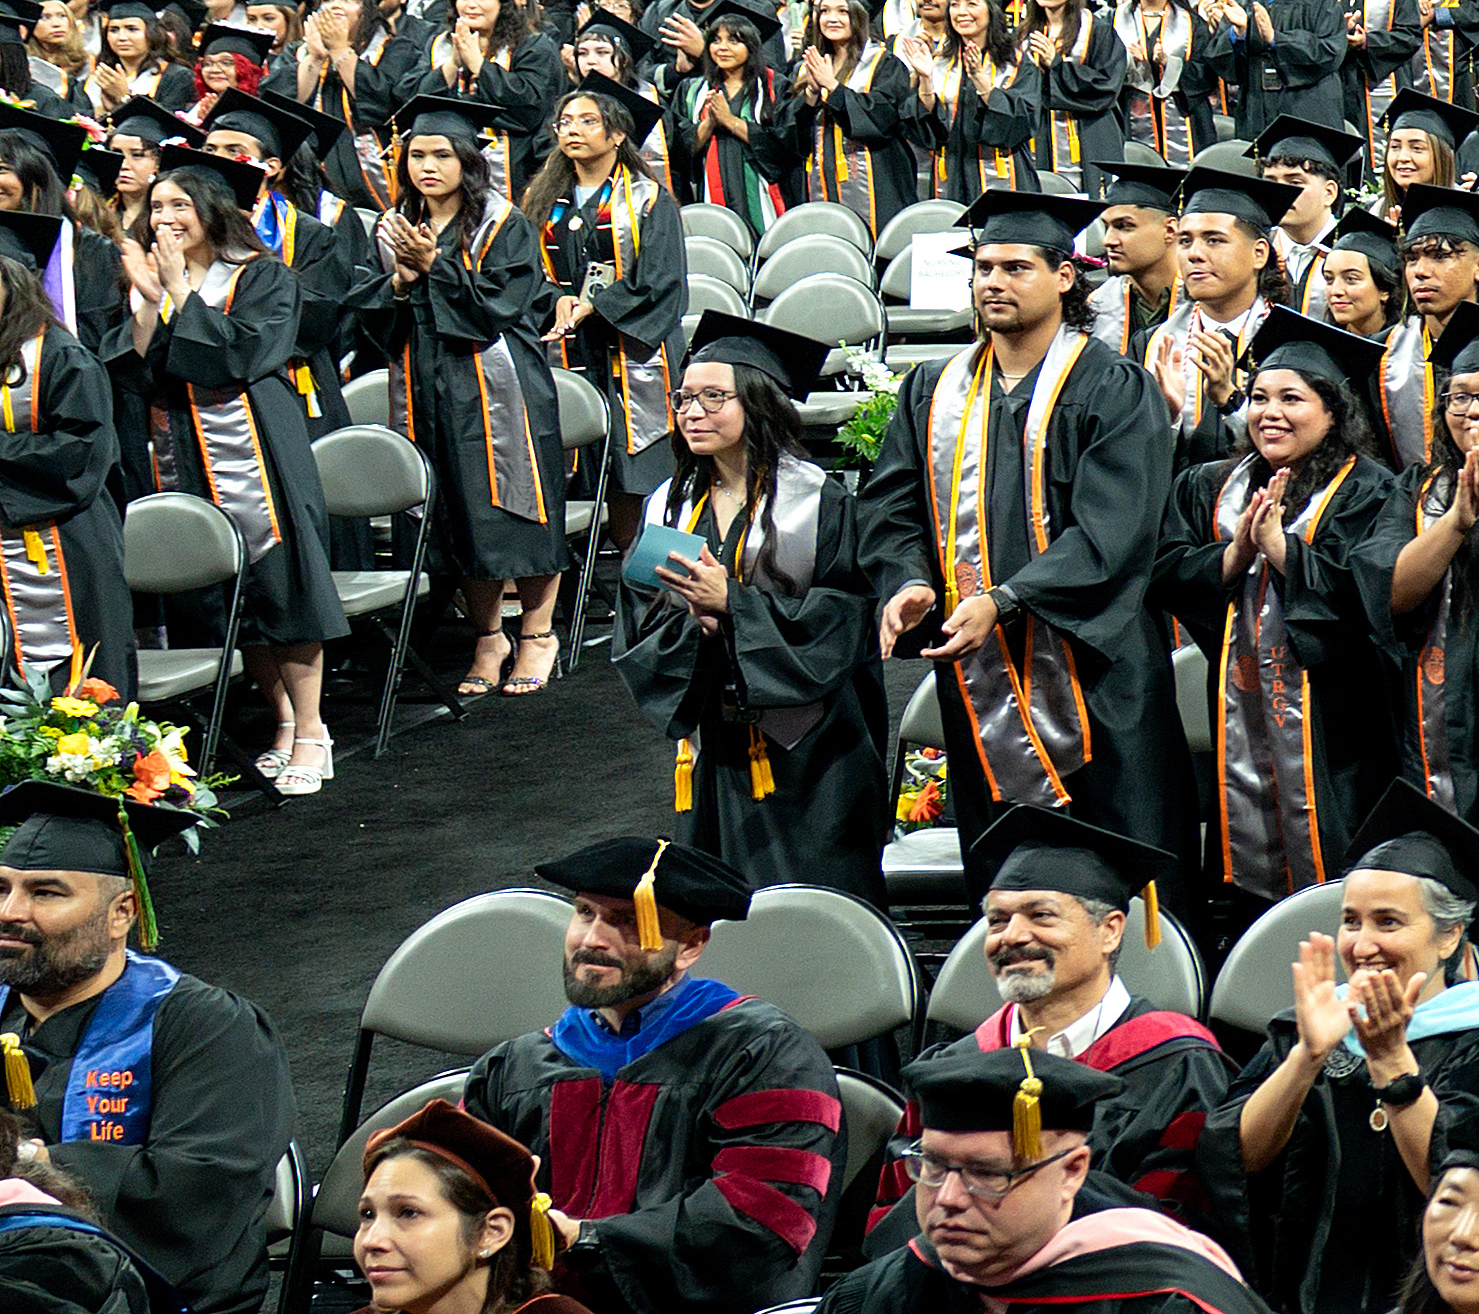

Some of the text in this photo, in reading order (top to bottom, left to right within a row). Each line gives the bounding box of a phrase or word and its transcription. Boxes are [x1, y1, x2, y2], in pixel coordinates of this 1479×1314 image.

[1269, 646, 1288, 729] UTRGV
[85, 1069, 134, 1090] Keep
[86, 1095, 129, 1115] Your
[90, 1120, 125, 1142] Life
